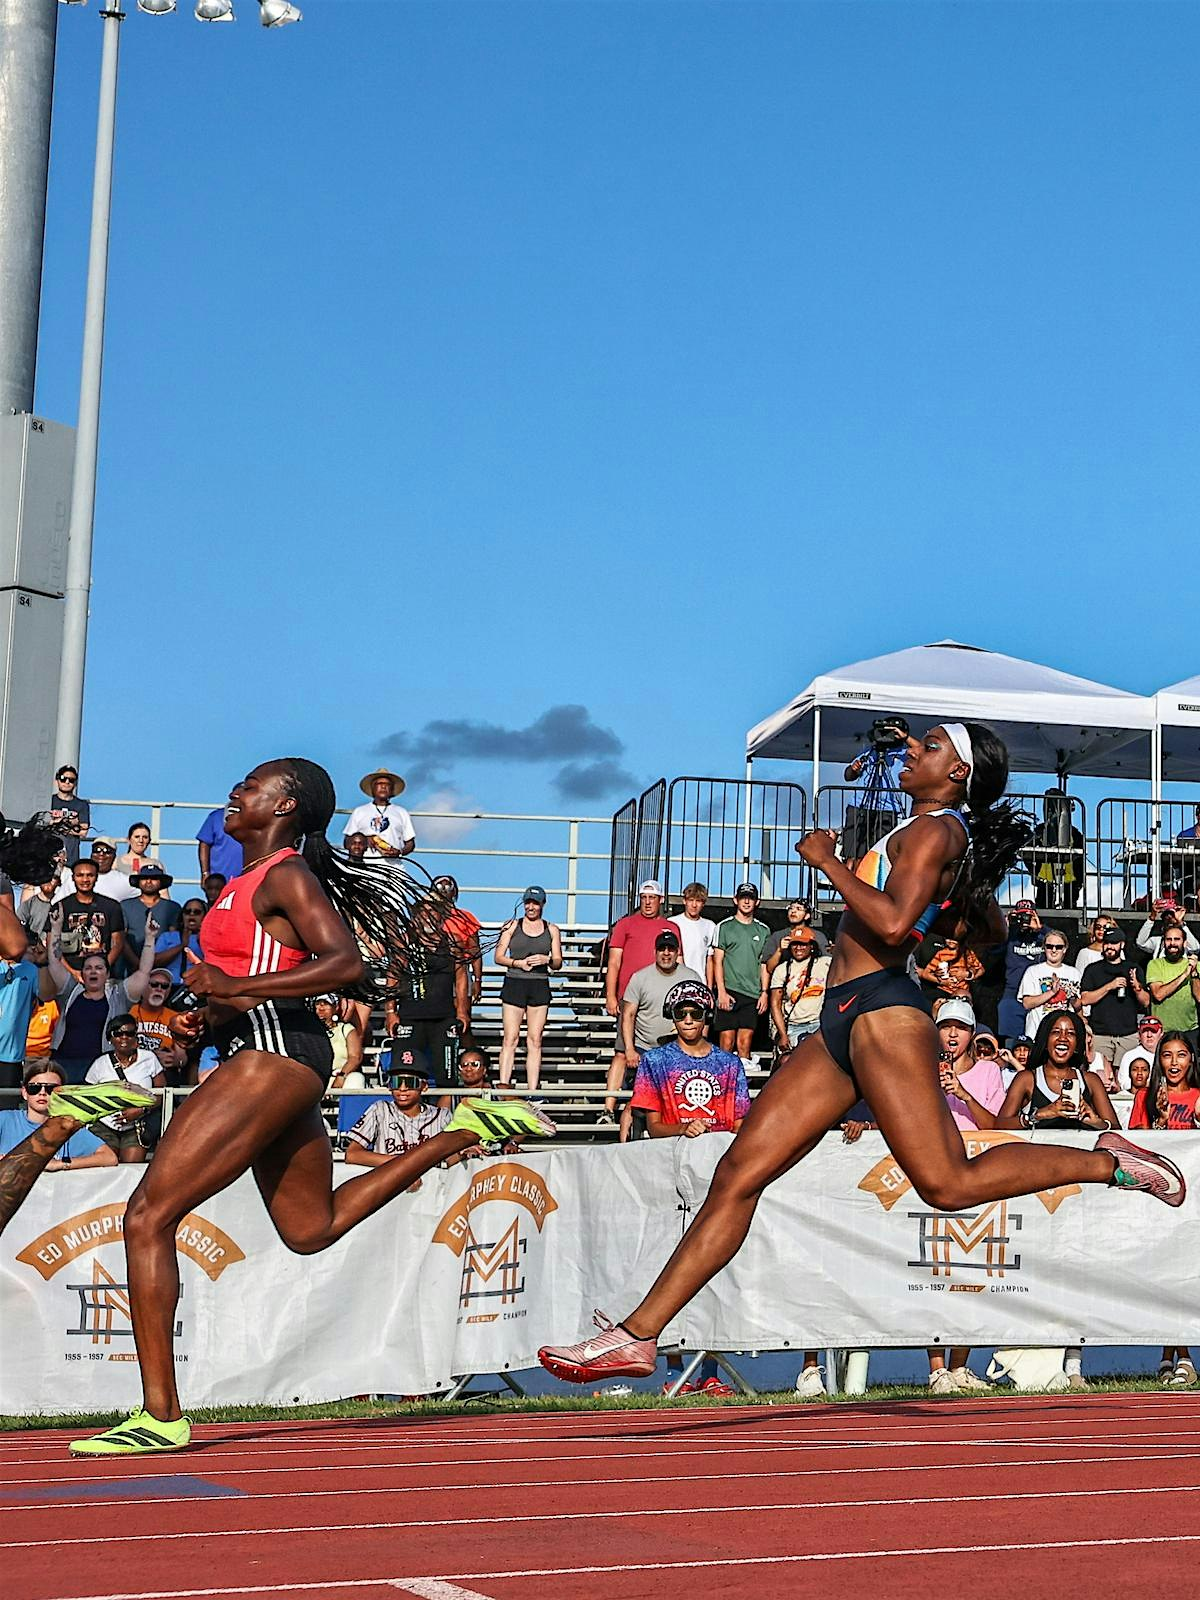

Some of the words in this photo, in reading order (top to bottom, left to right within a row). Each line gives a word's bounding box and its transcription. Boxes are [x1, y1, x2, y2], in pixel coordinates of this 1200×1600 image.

[32, 421, 44, 432] S4
[19, 595, 30, 606] S4
[674, 1070, 698, 1094] UNITED
[699, 1070, 721, 1096] STATES
[879, 1166, 906, 1191] ED
[447, 1214, 468, 1238] ED
[470, 1174, 506, 1201] RPHEY
[510, 1175, 546, 1215] CLASSIC
[36, 1242, 63, 1265] ED
[62, 1214, 124, 1251] MURPH
[177, 1224, 228, 1264] ASSIC
[990, 1285, 1029, 1293] CHAMPION
[64, 1353, 81, 1361] 1955
